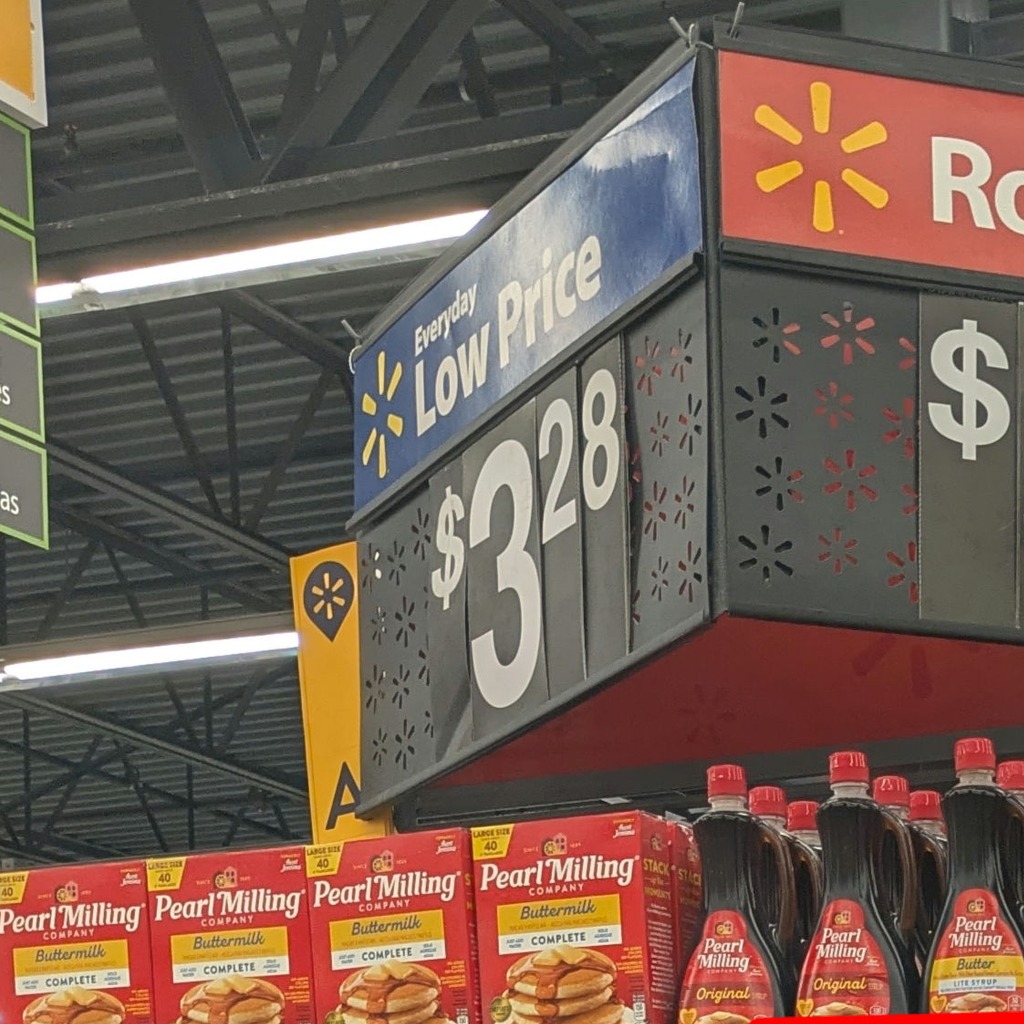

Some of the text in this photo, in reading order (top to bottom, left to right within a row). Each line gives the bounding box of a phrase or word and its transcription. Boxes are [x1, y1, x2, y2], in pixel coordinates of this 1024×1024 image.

[415, 283, 478, 357] Everyday
[414, 235, 602, 437] Low Price
[325, 761, 361, 831] A
[480, 856, 634, 890] Pearl Milling
[314, 872, 456, 907] Pearl Milling
[529, 883, 584, 897] COMPANY
[155, 889, 301, 921] Pearl Milling
[359, 899, 410, 913] COMPANY
[521, 900, 597, 920] Buttermilk
[0, 903, 141, 934] Pearl Milling
[201, 915, 253, 927] COMPANY
[352, 915, 422, 936] Buttermilk
[955, 916, 995, 932] Pearl
[43, 929, 94, 941] COMPANY
[193, 931, 266, 950] Buttermilk
[531, 932, 586, 946] COMPLETE
[821, 929, 861, 944] Pearl
[949, 932, 1002, 950] Milling
[35, 944, 107, 963] Buttermilk
[362, 947, 412, 961] COMPLETE
[705, 938, 744, 954] Pearl
[816, 944, 867, 962] Milling
[204, 963, 255, 975] COMPLETE
[698, 953, 750, 971] Milling
[957, 959, 995, 970] Butter
[46, 975, 96, 987] COMPLETE
[814, 978, 867, 993] Original
[696, 988, 750, 1003] Original
